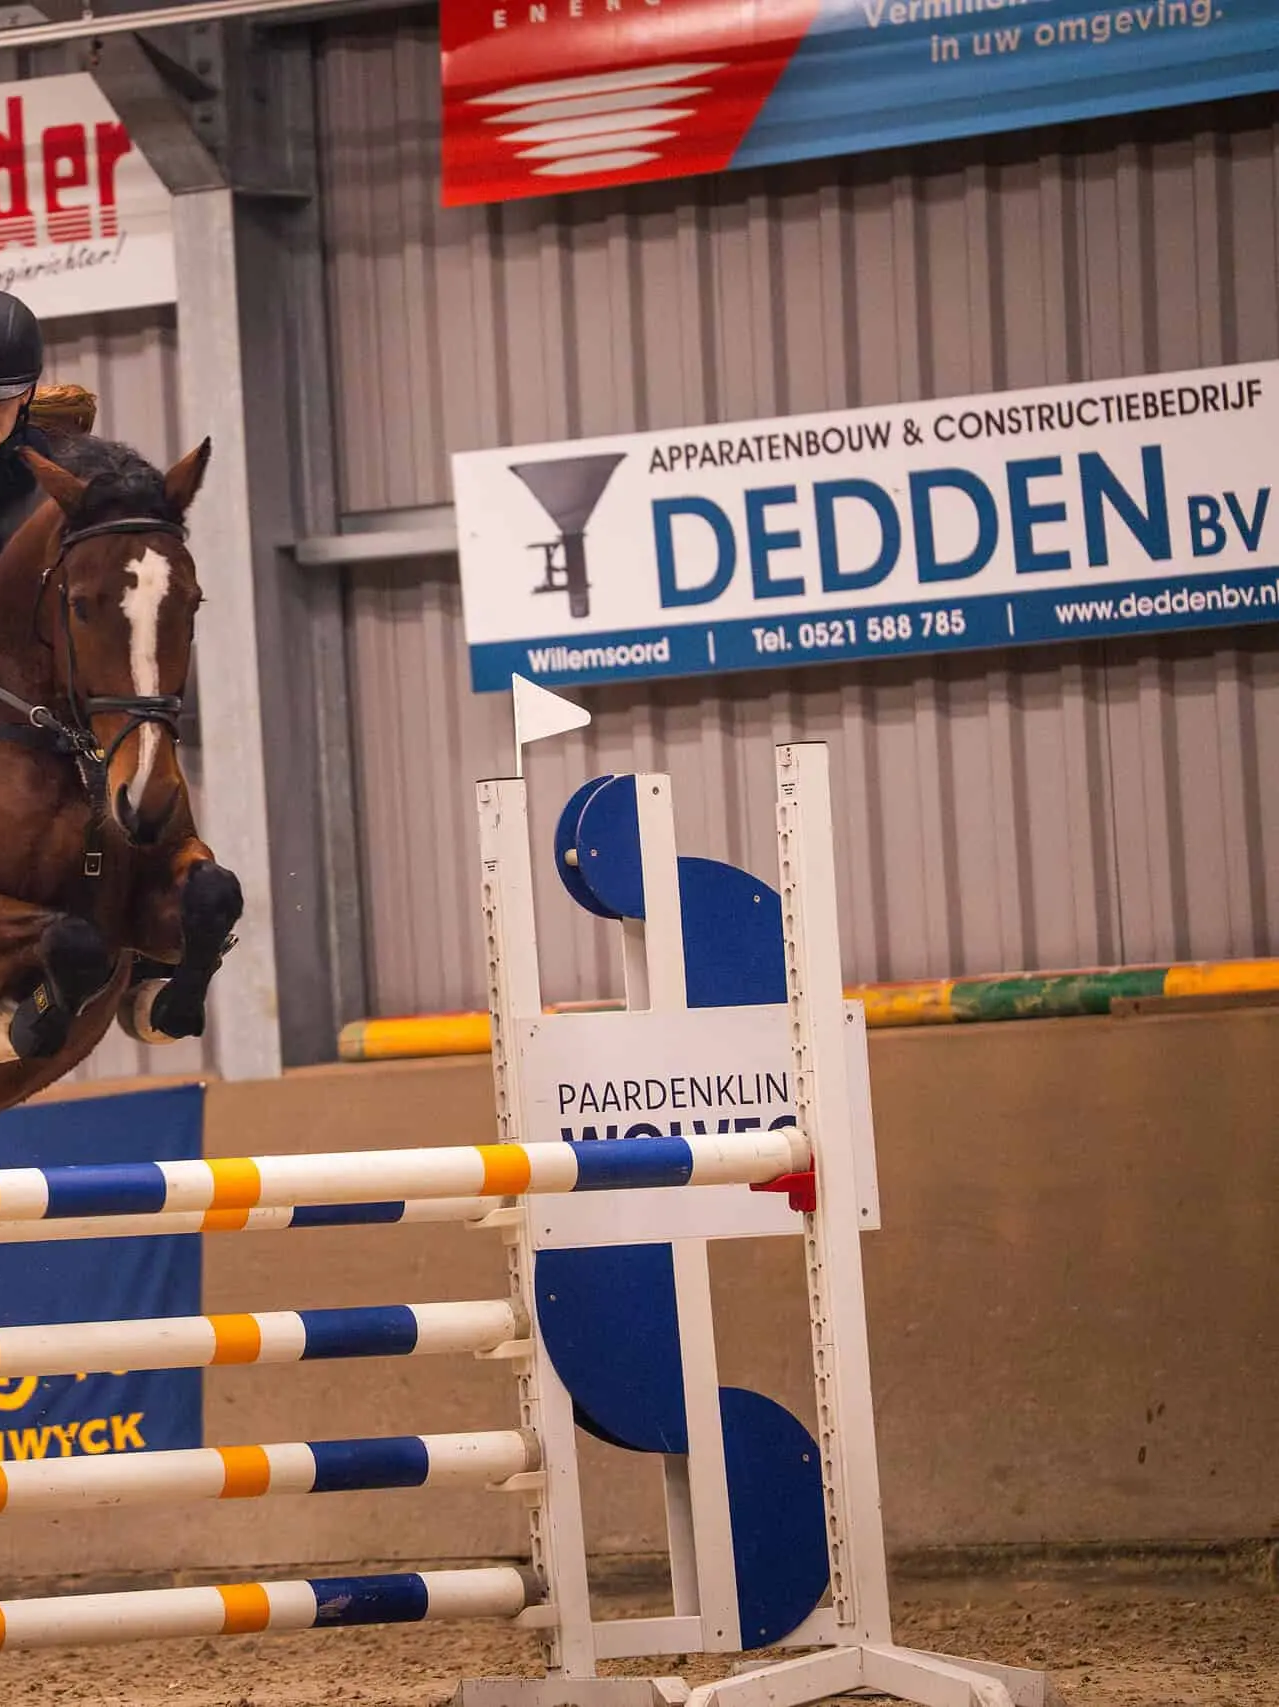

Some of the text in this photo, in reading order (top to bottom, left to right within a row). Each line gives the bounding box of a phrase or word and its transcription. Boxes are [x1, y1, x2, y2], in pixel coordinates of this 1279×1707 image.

[492, 0, 661, 30] ENER
[930, 0, 1223, 63] in uw omgeving.
[648, 379, 1263, 474] APPARATENBOUW & CONSTRUCTIEBEDRIJF
[651, 444, 1271, 609] DEDDEN BV
[1055, 579, 1279, 625] www.deddenbv.nl
[752, 609, 966, 653] Tel. 0521 588 785
[528, 637, 670, 674] Willemsoord
